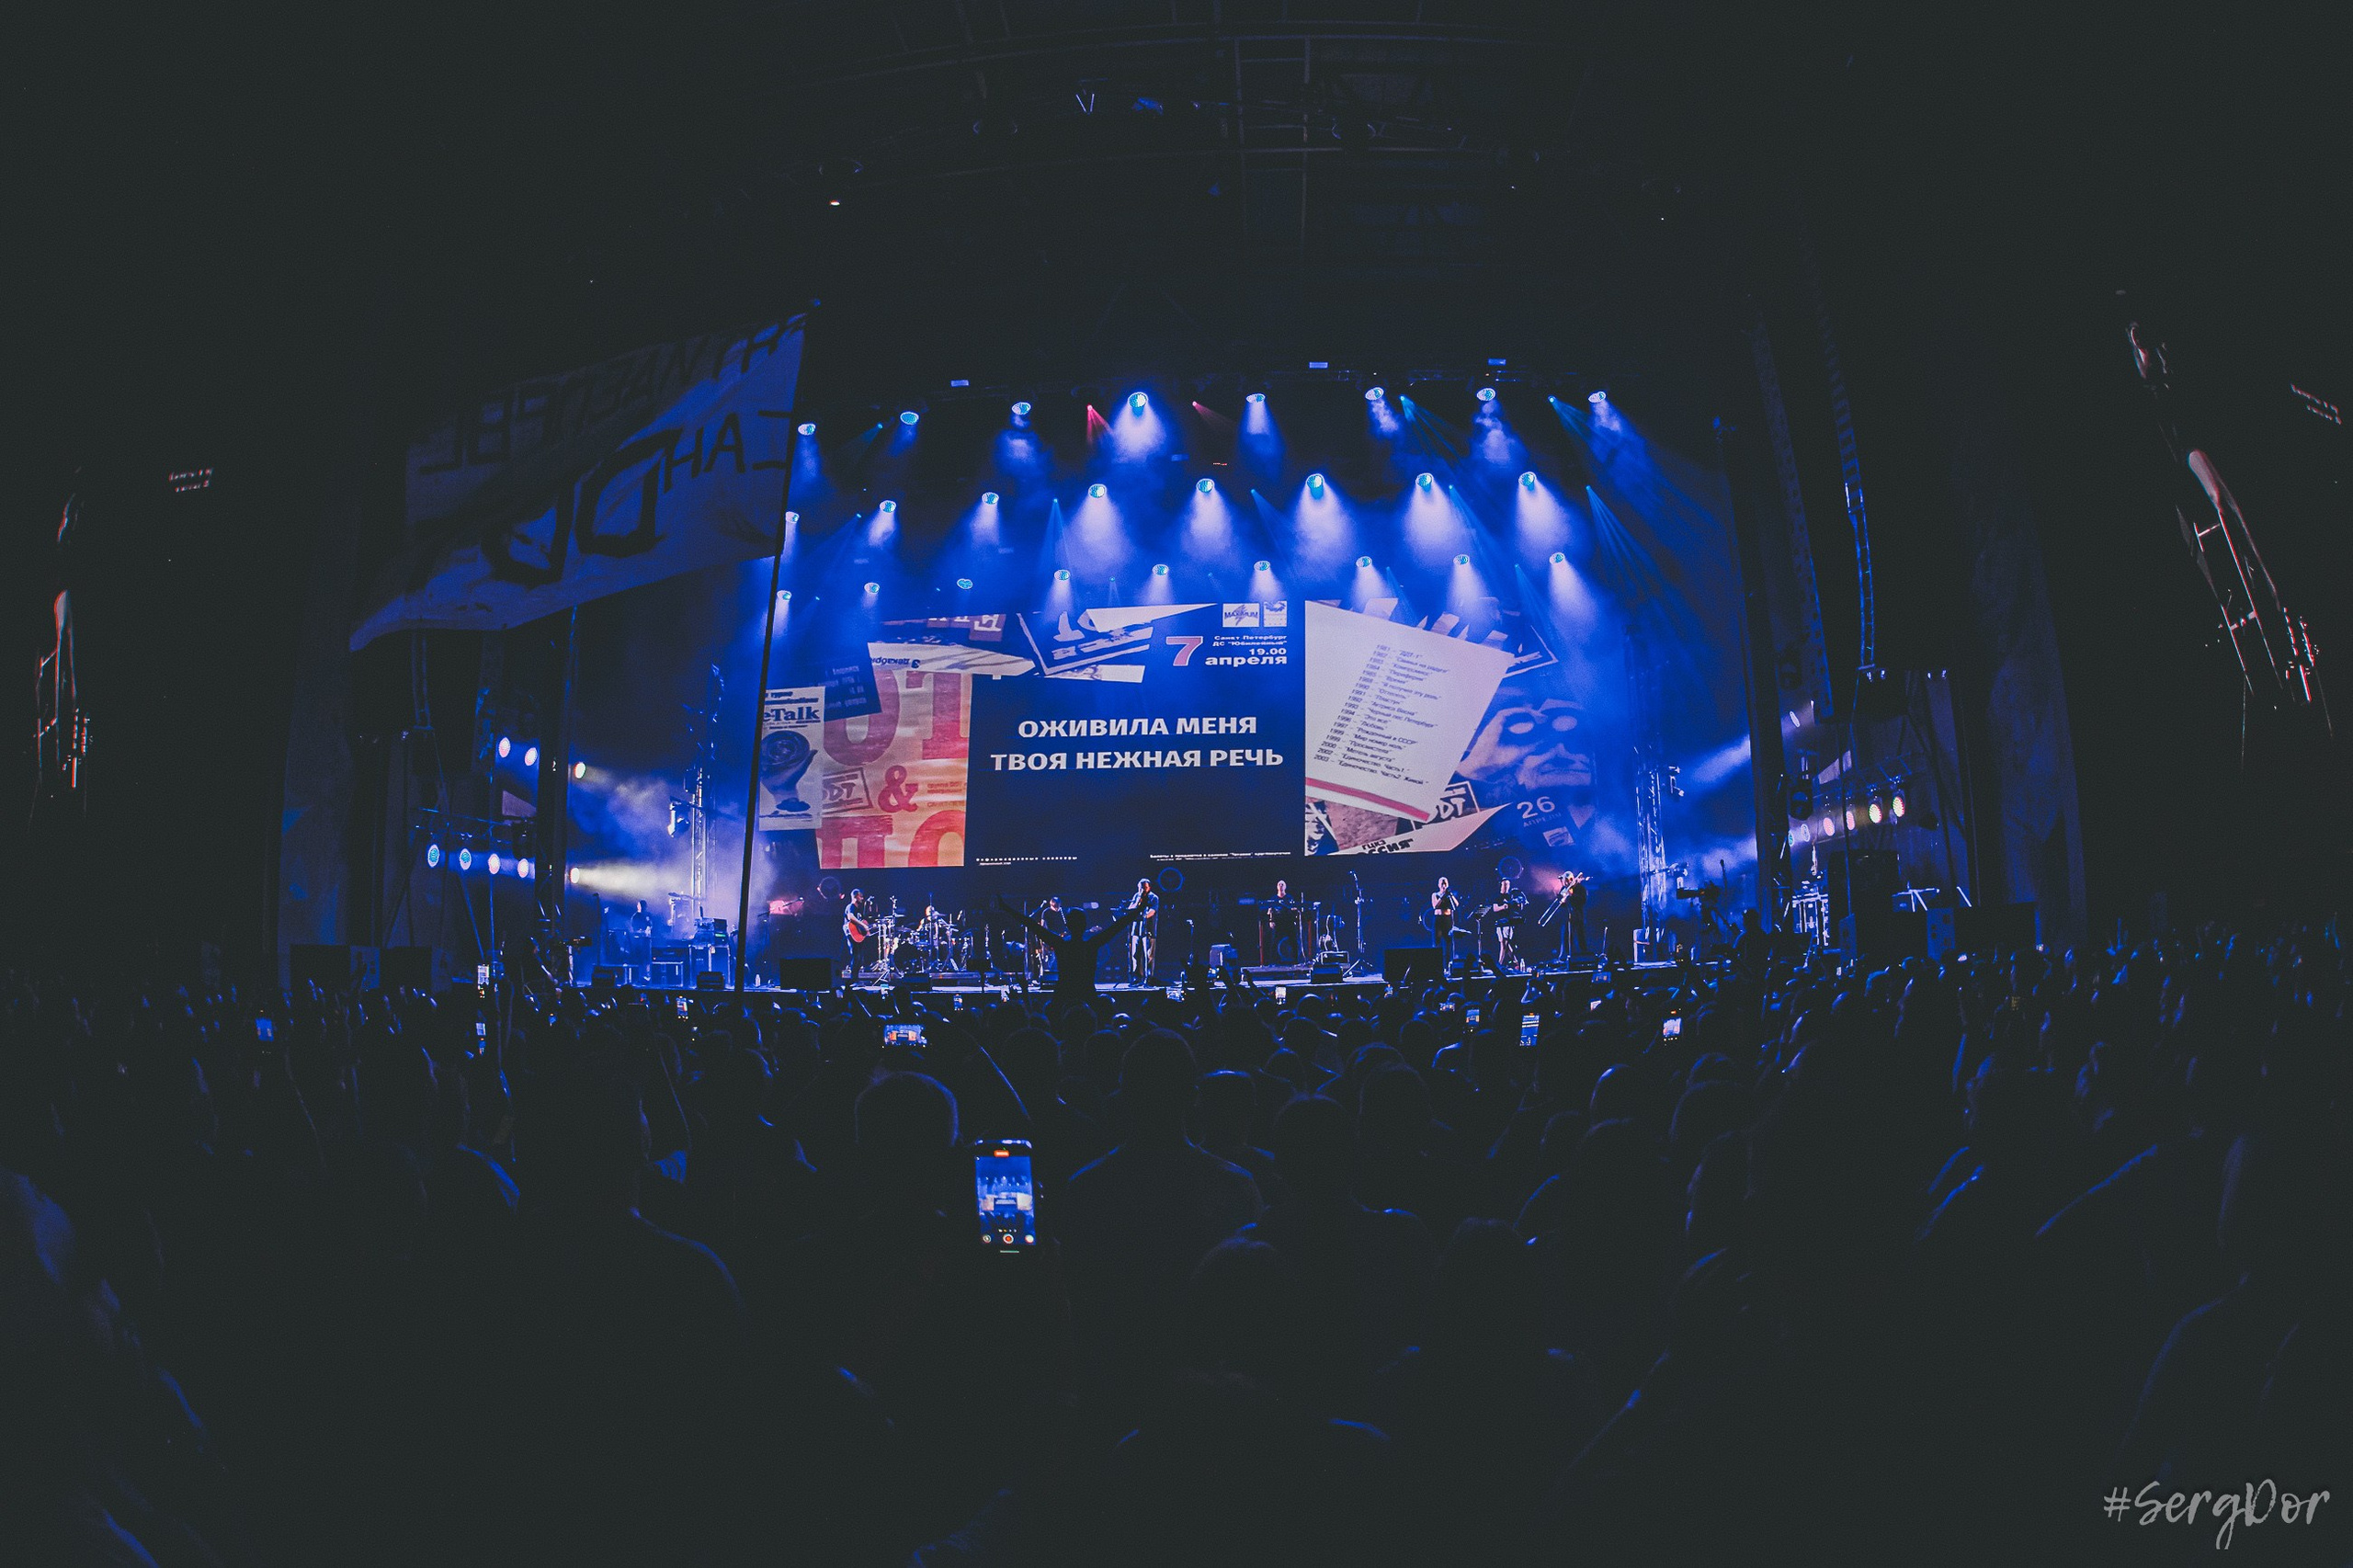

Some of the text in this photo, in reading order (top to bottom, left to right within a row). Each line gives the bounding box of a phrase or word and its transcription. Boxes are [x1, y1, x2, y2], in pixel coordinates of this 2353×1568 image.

[1165, 636, 1203, 666] 7
[1205, 656, 1287, 667] апреля
[911, 659, 920, 669] 3
[1017, 717, 1256, 738] ОЖИВИЛА МЕНЯ
[991, 749, 1284, 771] ТВОЯ НЕЖНАЯ РЕЧЬ
[878, 765, 918, 812] &
[1432, 797, 1466, 820] DT
[1517, 796, 1555, 819] 26
[1361, 839, 1386, 850] ГЦКЗ
